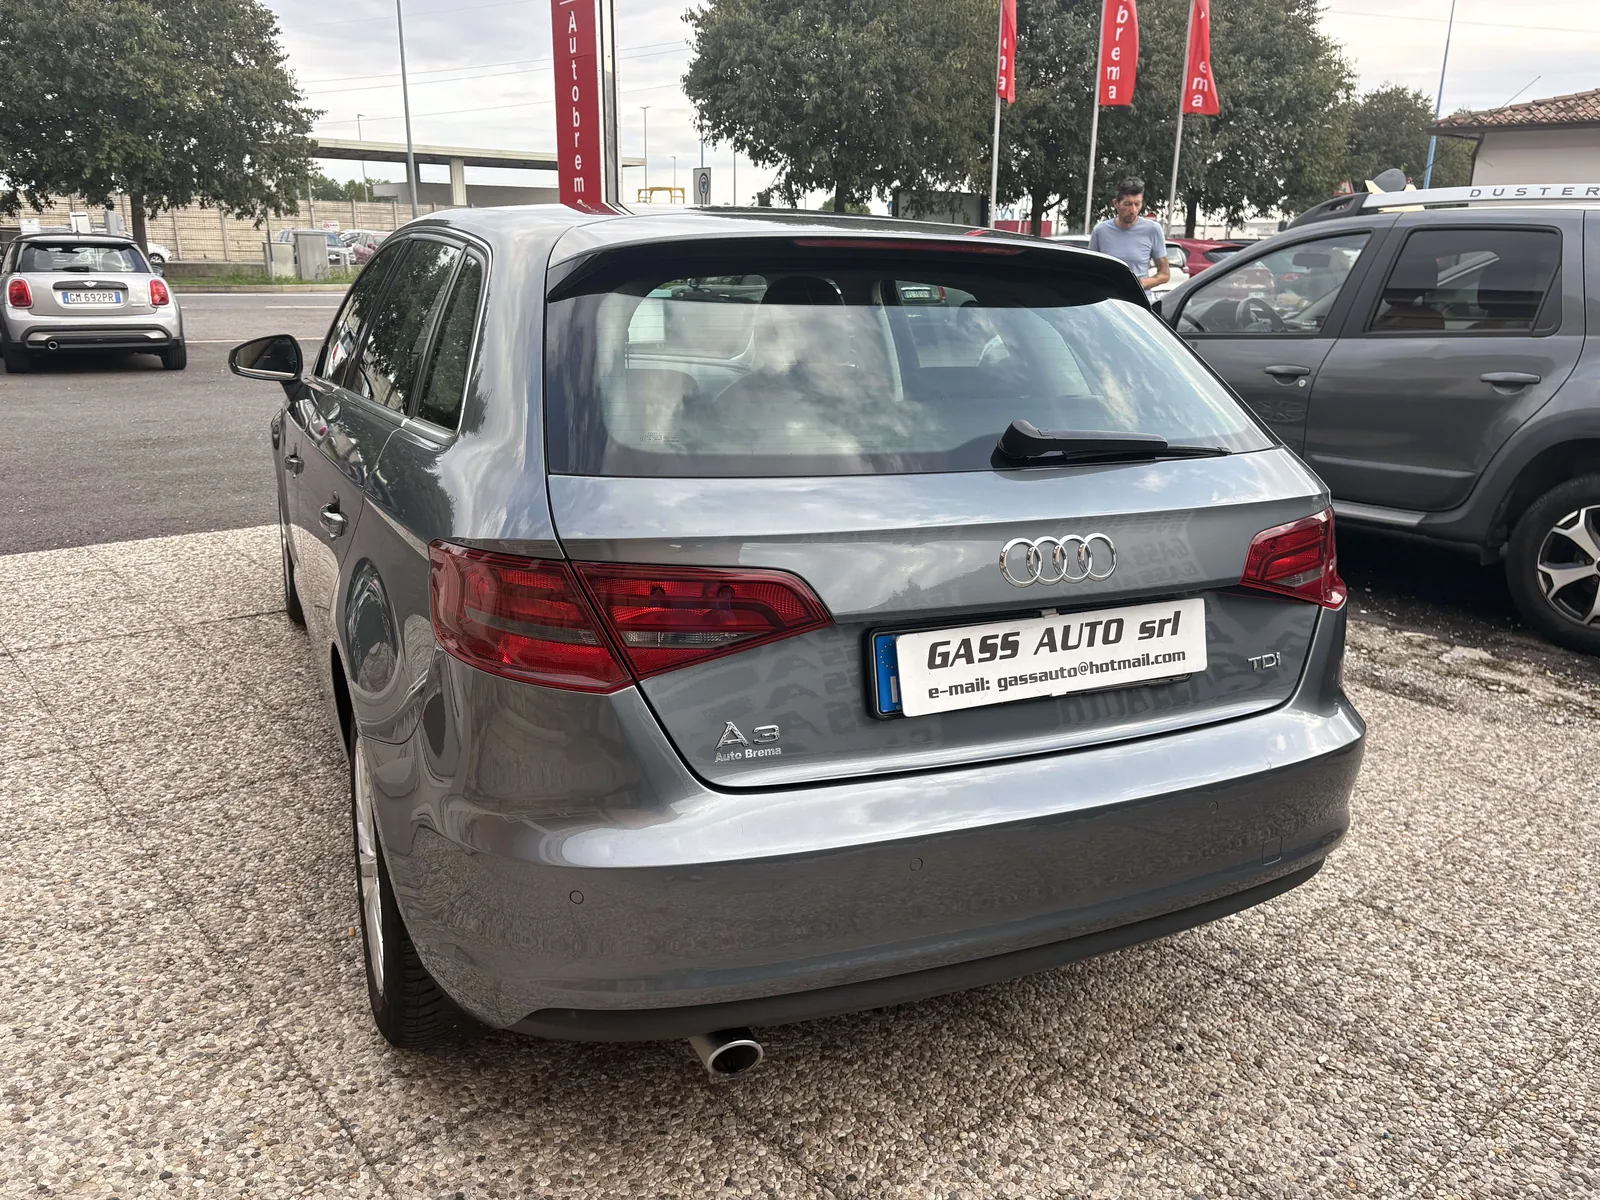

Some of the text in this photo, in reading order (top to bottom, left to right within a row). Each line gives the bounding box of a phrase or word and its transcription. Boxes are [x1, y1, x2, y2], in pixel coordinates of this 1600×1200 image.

[1107, 0, 1128, 99] brema
[568, 11, 585, 204] Autobrem
[1469, 187, 1600, 198] DUSTER
[927, 611, 1182, 670] GASS AUTO srl
[928, 651, 1186, 699] e-mail: gassauto@hotmail.com
[1247, 651, 1281, 671] TDI
[714, 721, 780, 751] A3
[714, 747, 782, 763] Auto Brema
